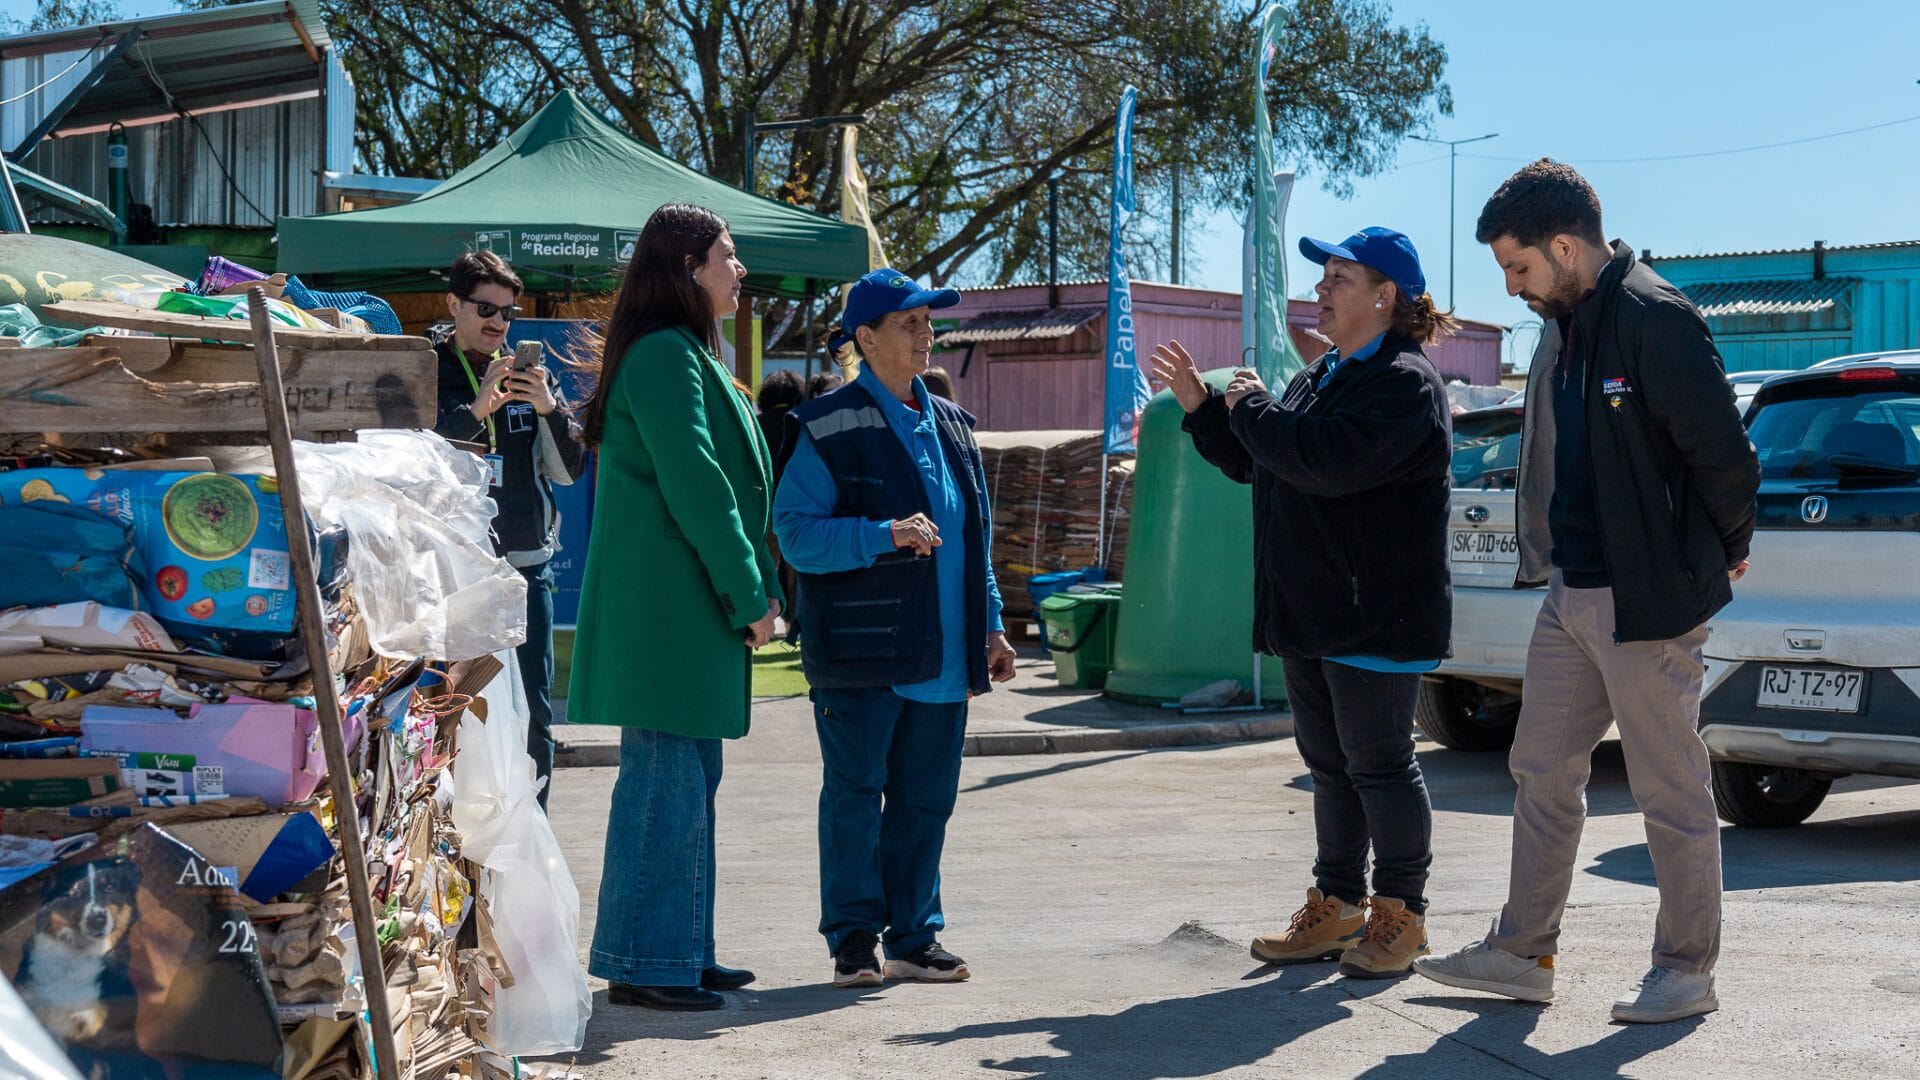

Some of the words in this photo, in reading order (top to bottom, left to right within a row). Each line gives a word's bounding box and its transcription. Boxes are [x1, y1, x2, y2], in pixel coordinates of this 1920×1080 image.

[521, 232, 562, 243] Programa
[563, 232, 600, 242] Regional
[521, 242, 533, 250] de
[534, 243, 599, 259] Reciclaje
[1113, 286, 1135, 369] Papel
[1791, 698, 1825, 707] CHILE
